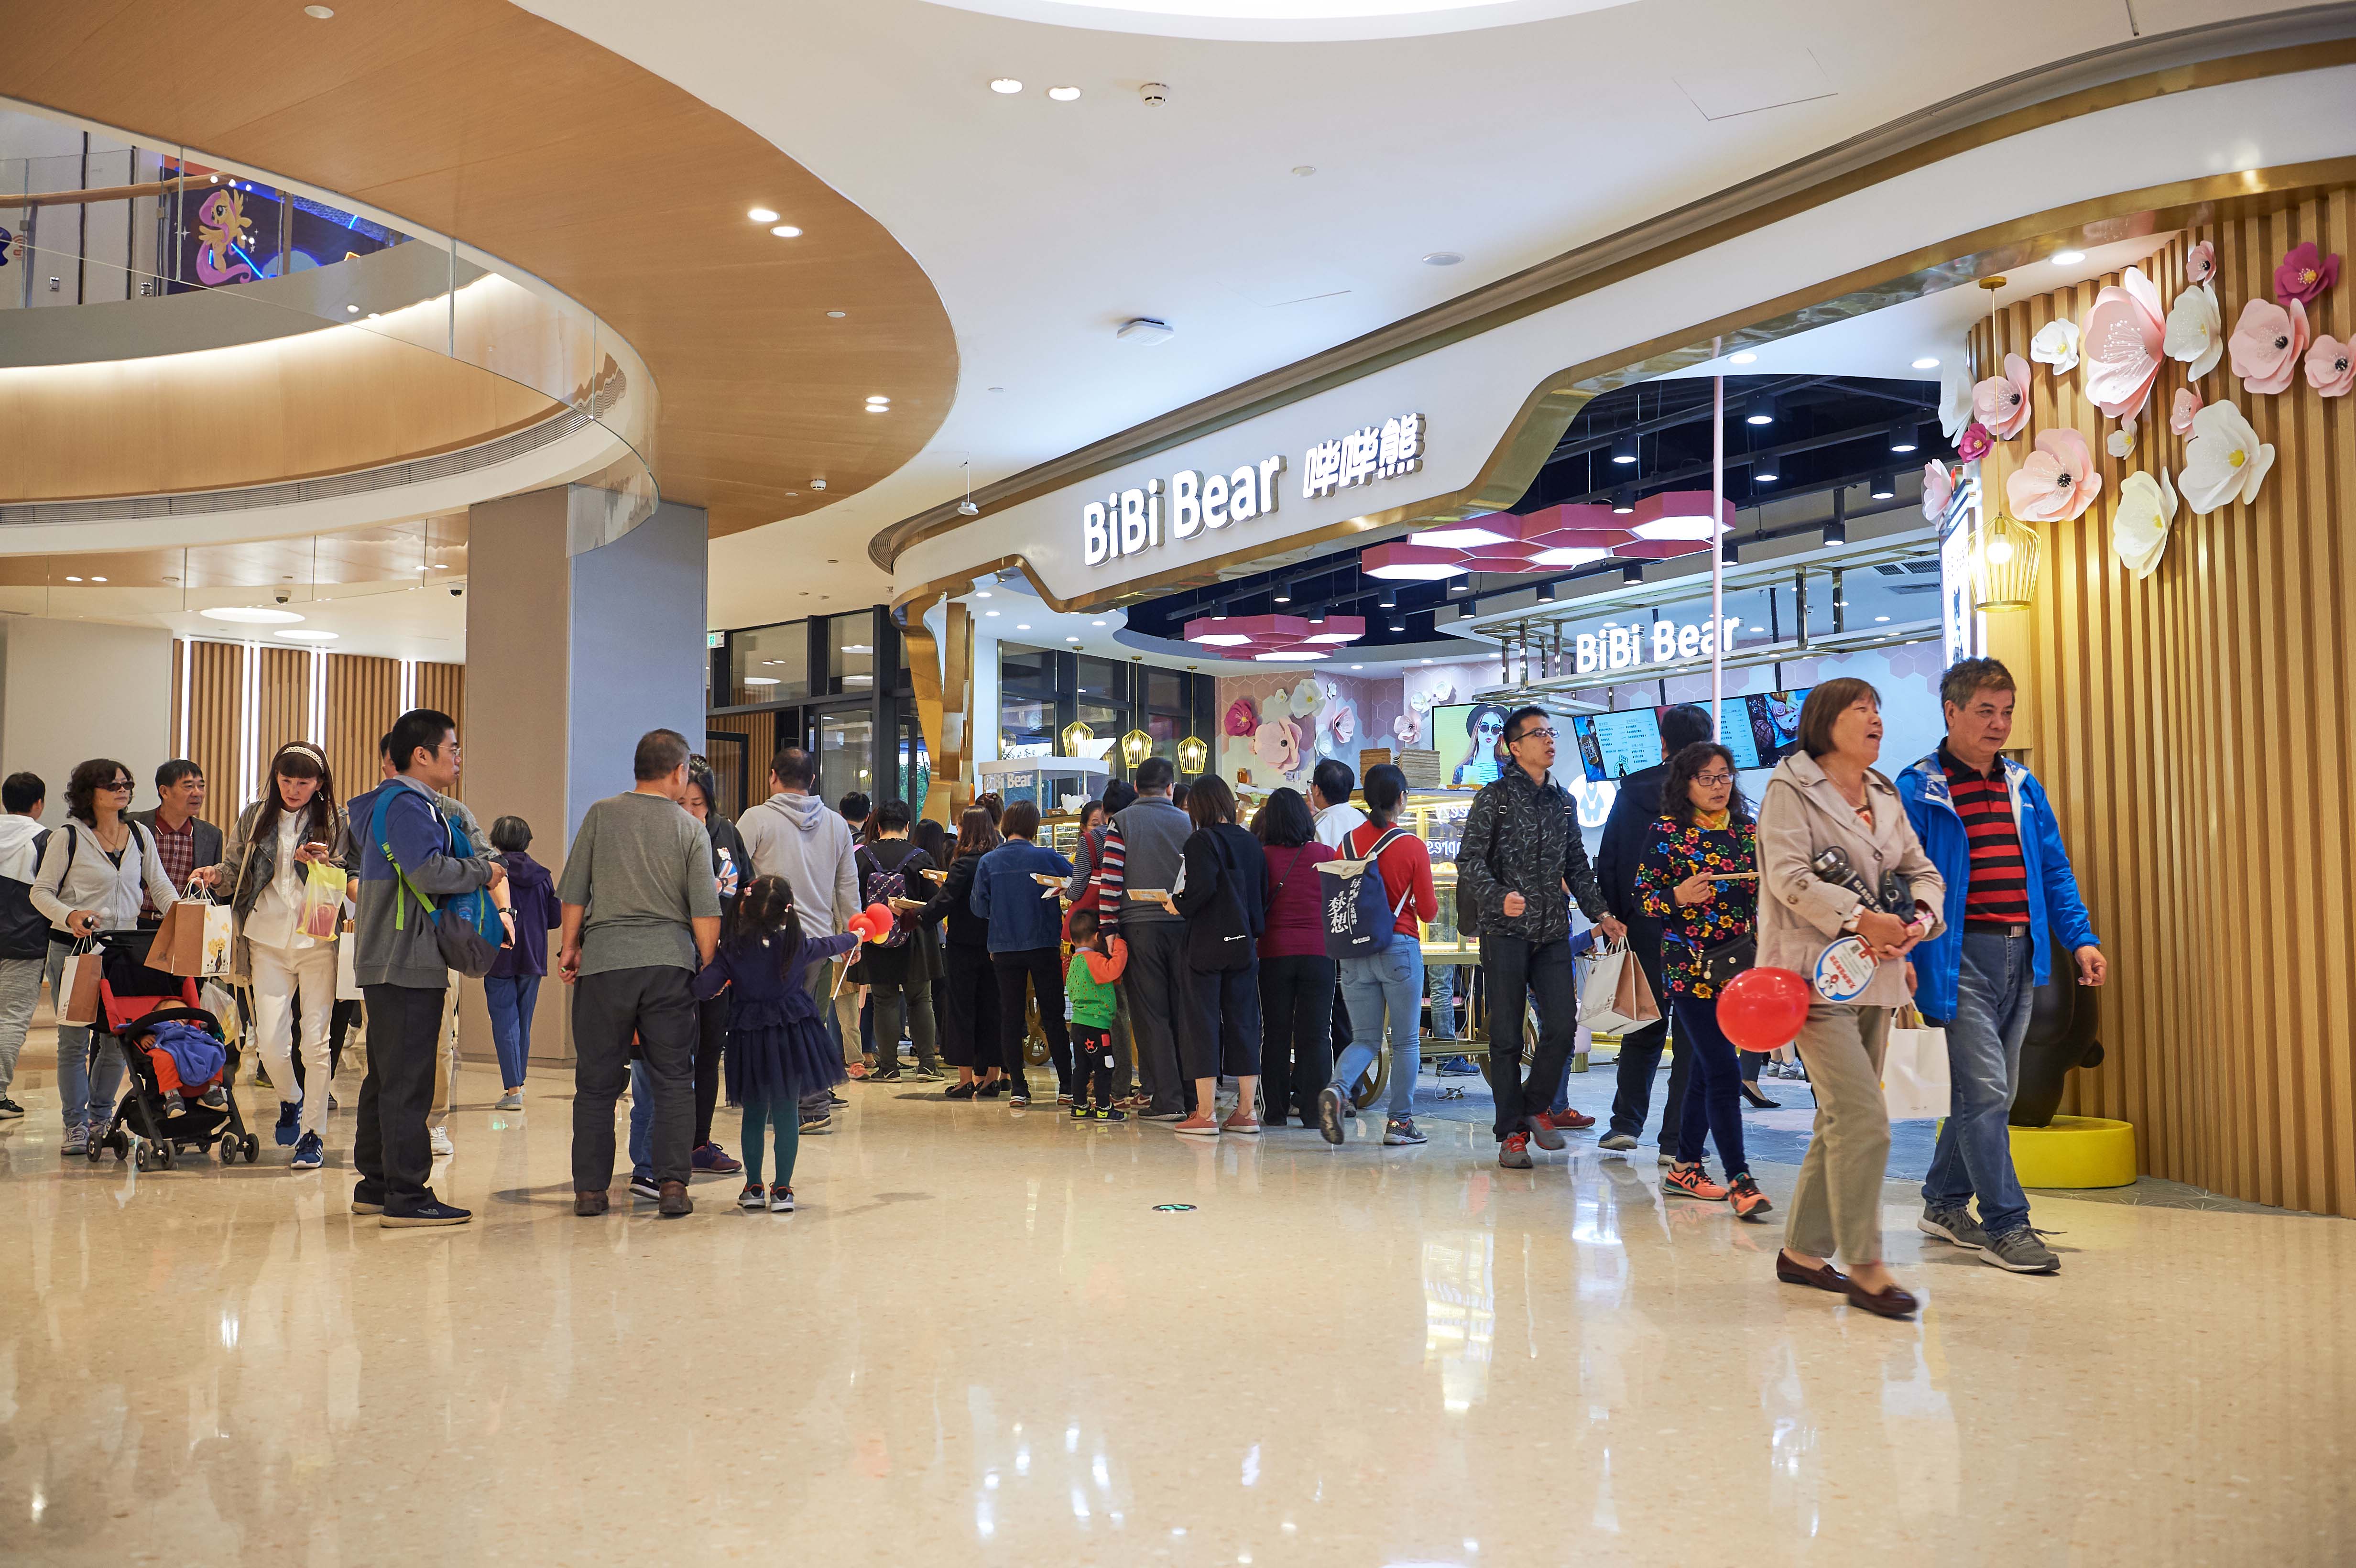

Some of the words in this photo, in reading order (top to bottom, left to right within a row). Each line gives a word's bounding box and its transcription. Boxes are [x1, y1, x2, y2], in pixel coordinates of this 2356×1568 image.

[1083, 478, 1164, 566] BiBi
[1173, 455, 1284, 539] Bear
[1576, 623, 1643, 674] BiBi
[1653, 617, 1741, 662] Bear
[983, 773, 1004, 790] BiBi
[1007, 773, 1033, 788] Bear
